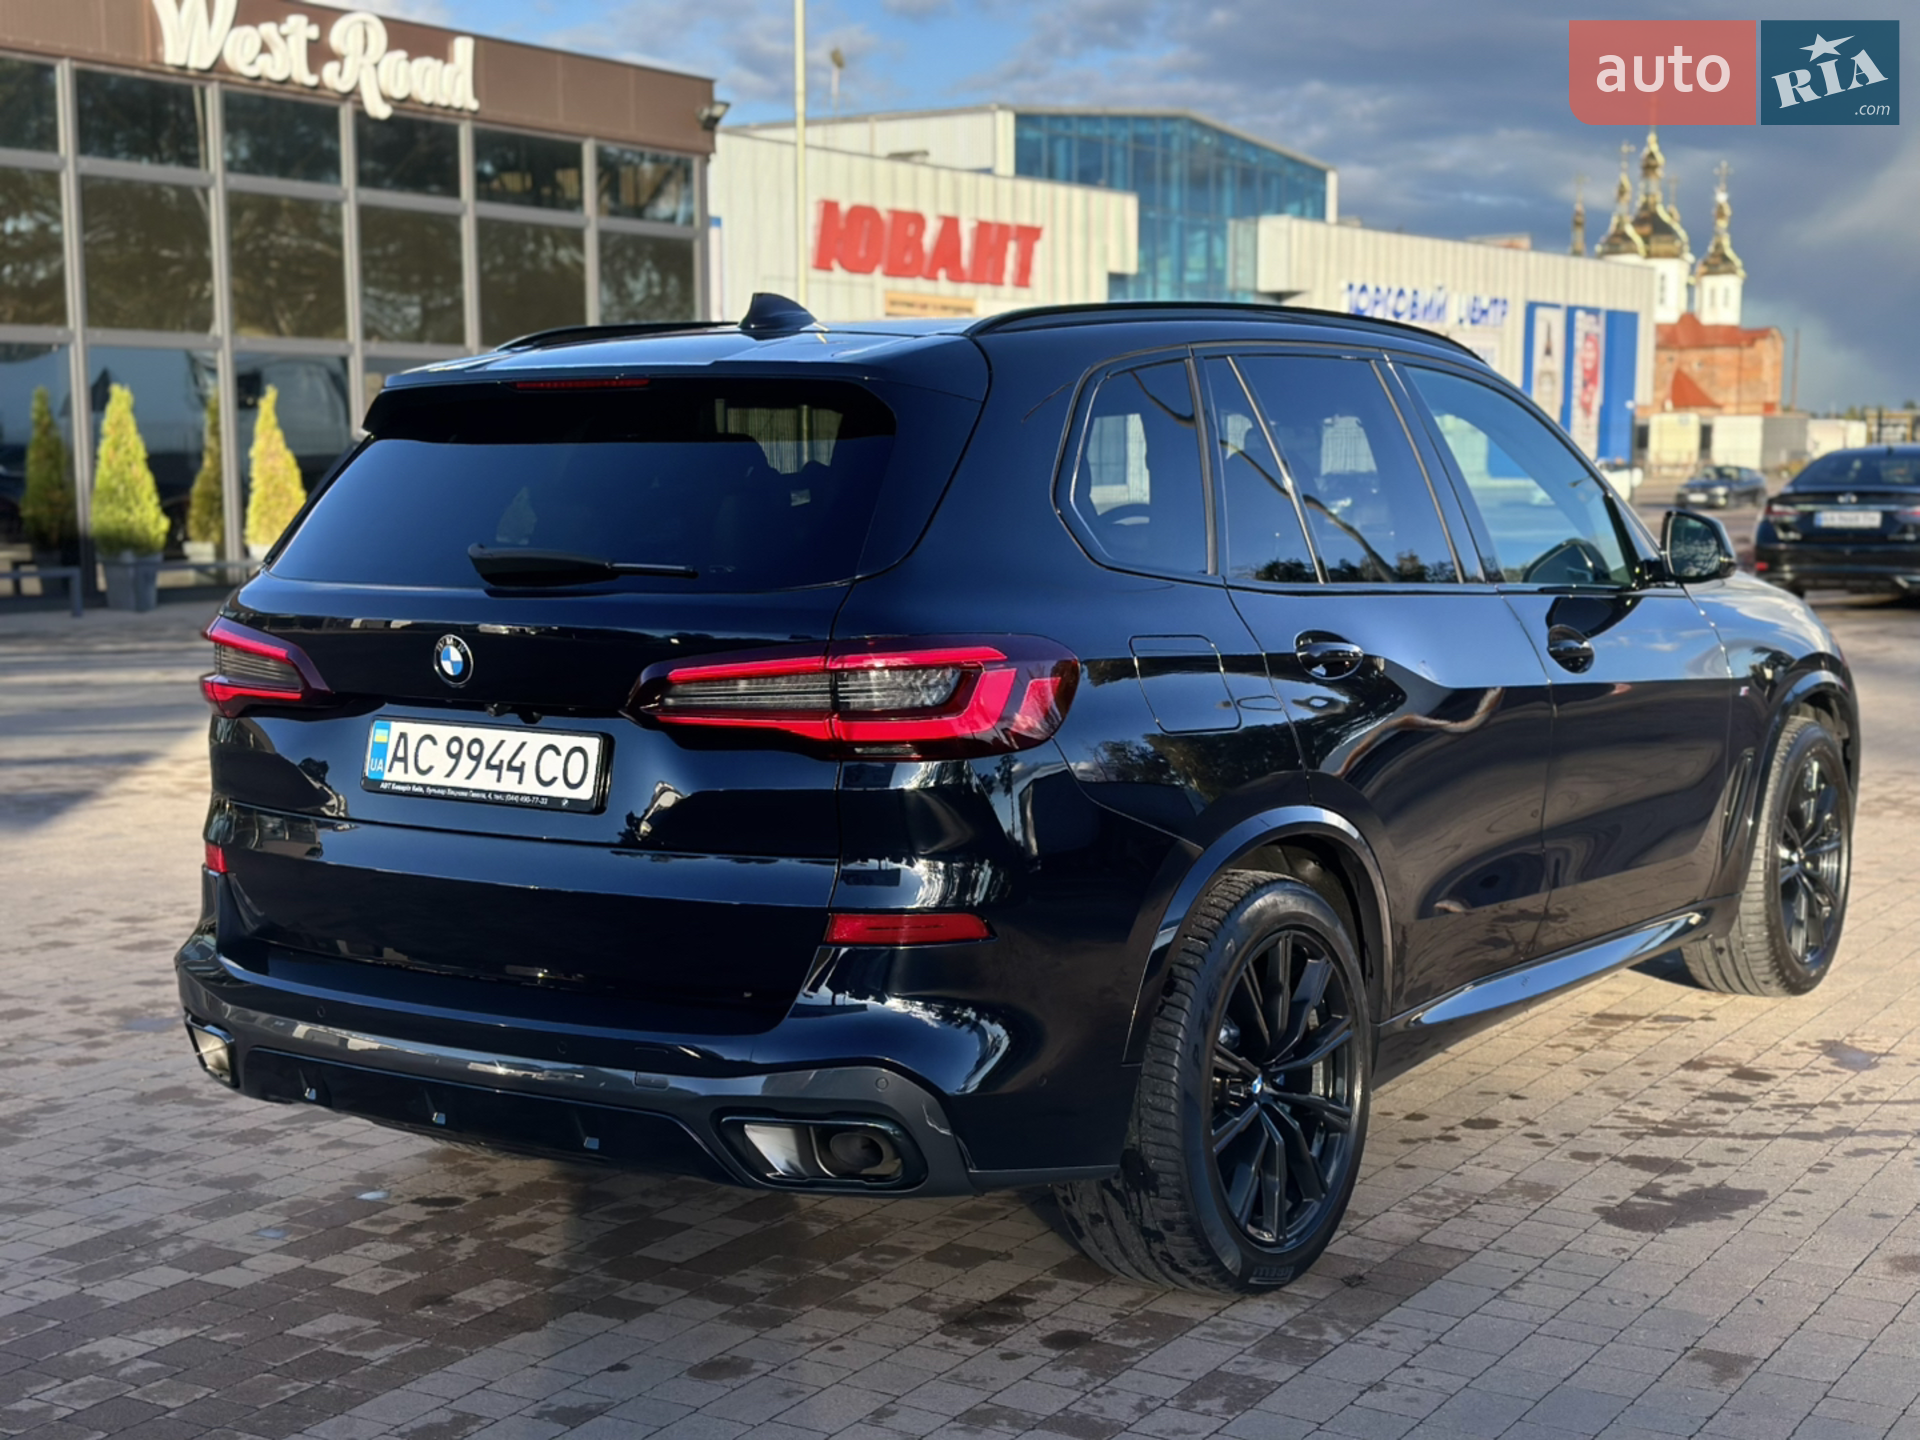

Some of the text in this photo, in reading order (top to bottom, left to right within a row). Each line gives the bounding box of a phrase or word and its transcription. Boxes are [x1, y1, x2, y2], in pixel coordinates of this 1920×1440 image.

[154, 0, 479, 120] West Road
[812, 199, 1043, 288] ЮВАНТ
[370, 758, 384, 772] UA
[387, 731, 589, 790] AC 9944 CO
